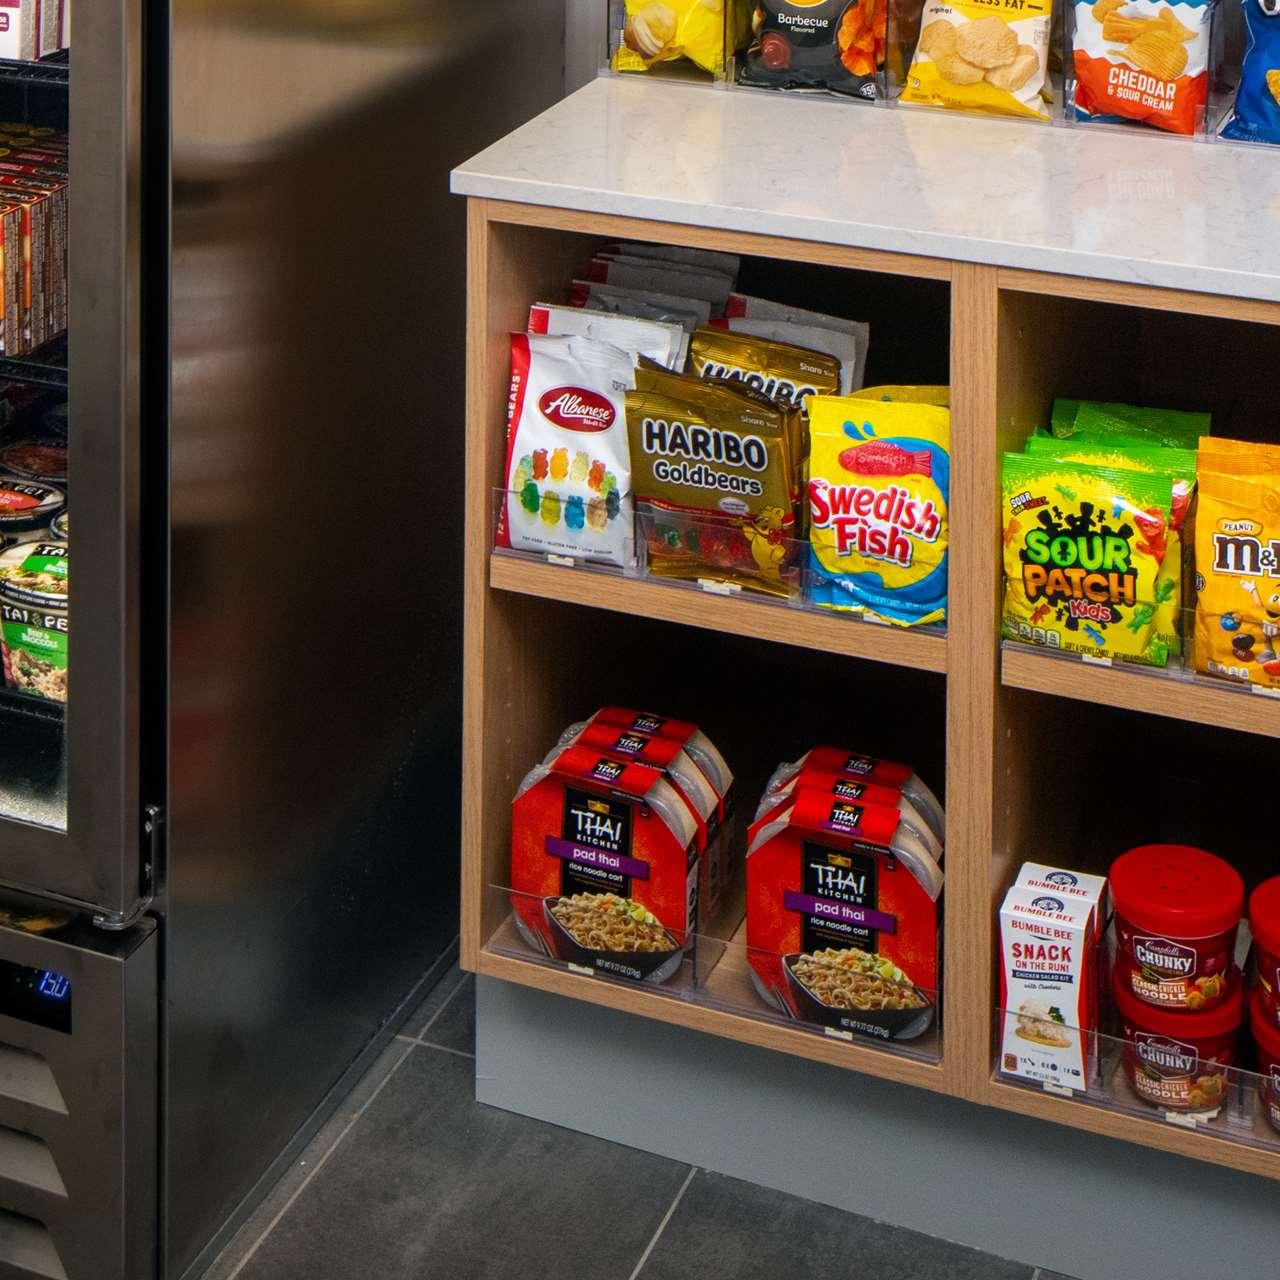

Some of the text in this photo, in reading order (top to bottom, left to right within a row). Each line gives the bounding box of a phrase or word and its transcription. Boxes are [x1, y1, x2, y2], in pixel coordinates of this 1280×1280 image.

[777, 12, 829, 29] Barbecue
[1108, 67, 1177, 100] CHEDDAR
[1117, 88, 1174, 111] SOUR CREAM
[544, 393, 612, 420] Albanese
[644, 419, 767, 471] HARIBO
[654, 460, 763, 496] Goldbears
[810, 479, 941, 540] Swedish
[1222, 521, 1255, 534] PEANUT
[832, 516, 912, 568] Fish
[1025, 529, 1130, 573] SOUR
[1023, 564, 1135, 603] PATCH
[2, 605, 29, 620] TAI
[1069, 599, 1112, 620] Kids
[571, 809, 622, 842] THAI
[576, 834, 618, 850] KITCHEN
[573, 847, 620, 868] pad thai
[569, 862, 623, 882] rice noodle cart
[810, 863, 865, 895] THAI
[817, 887, 863, 904] KITCHEN
[814, 901, 864, 921] pad thai
[1011, 920, 1073, 941] BUMBLE BEE
[1012, 943, 1072, 963] SNACK
[1135, 944, 1192, 972] CHUNKY
[1015, 960, 1069, 973] ON THE RUN!
[1015, 971, 1040, 979] CHICKEN
[1133, 987, 1187, 1000] NOODLE
